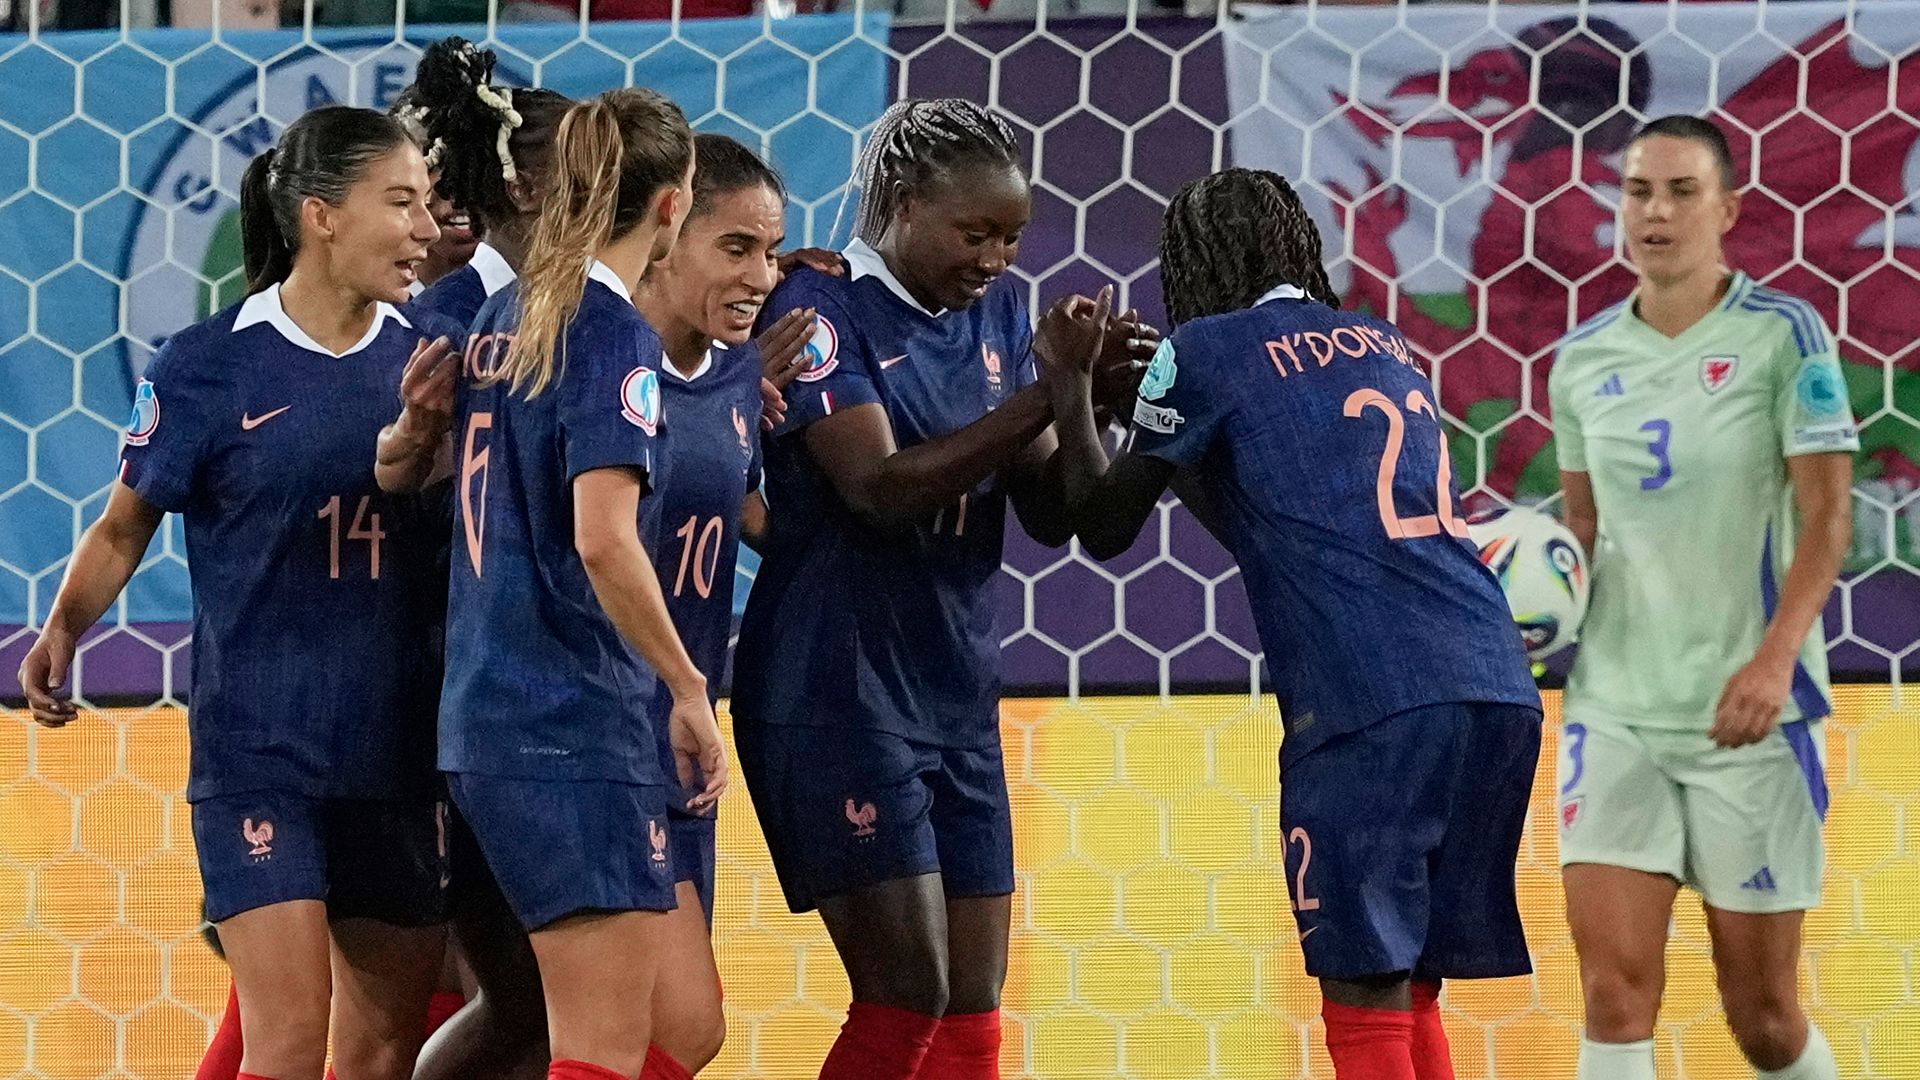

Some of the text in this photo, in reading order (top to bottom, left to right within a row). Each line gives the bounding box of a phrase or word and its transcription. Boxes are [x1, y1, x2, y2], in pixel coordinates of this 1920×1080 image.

[461, 412, 492, 579] 6
[1343, 388, 1470, 540] 22
[1638, 419, 1673, 491] 3
[318, 495, 386, 580] 14
[673, 515, 724, 599] 10
[1562, 721, 1589, 795] 3
